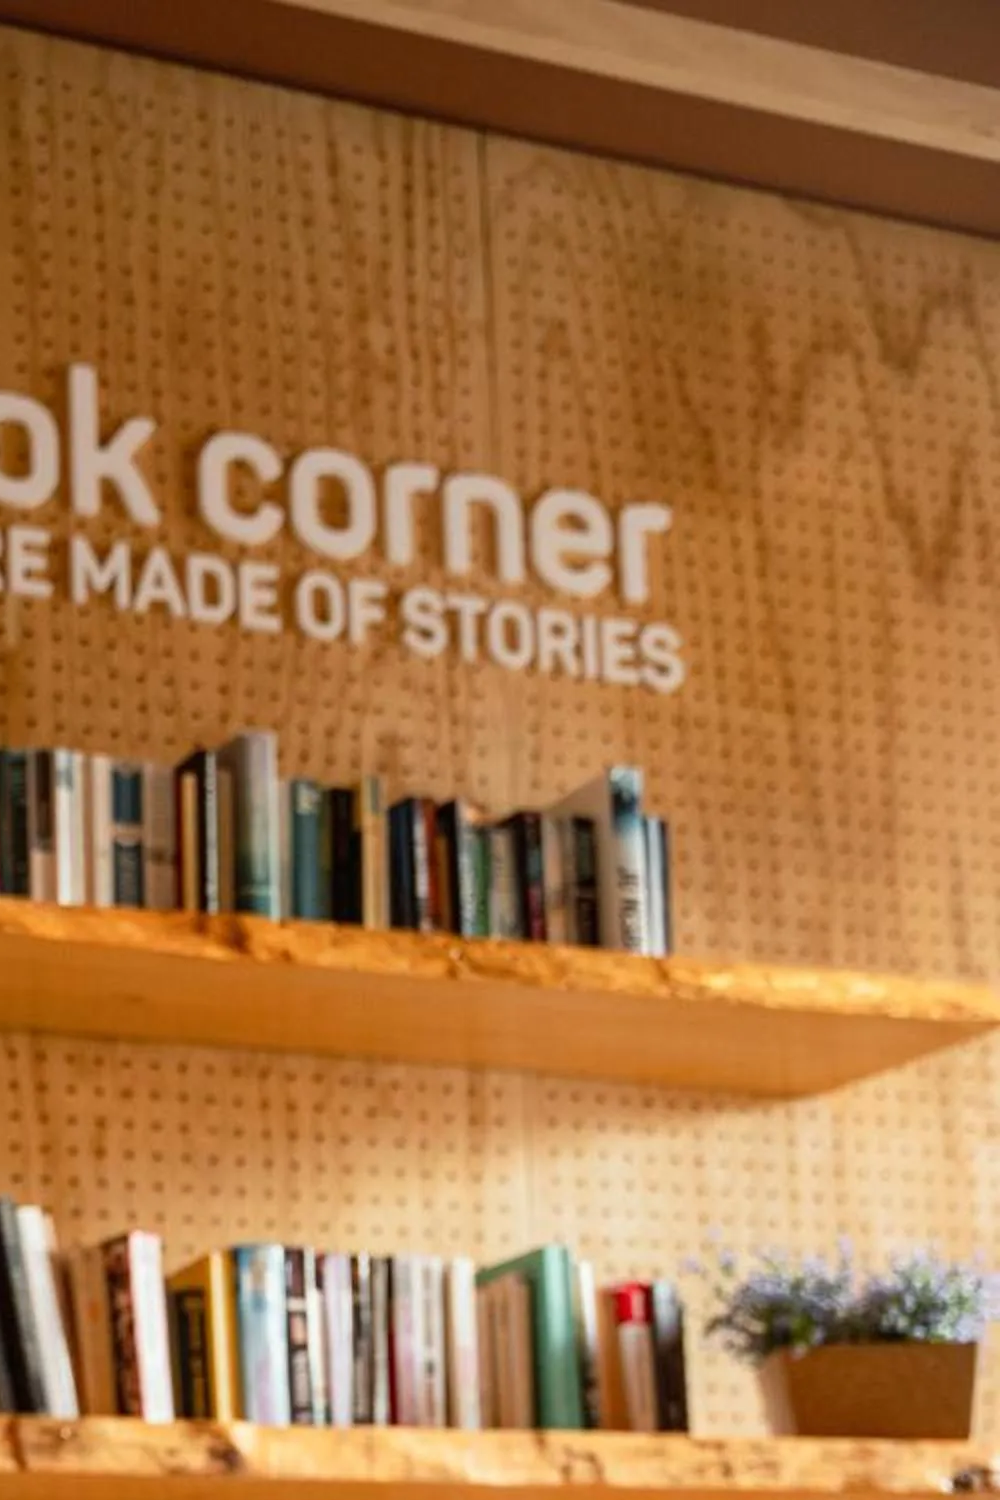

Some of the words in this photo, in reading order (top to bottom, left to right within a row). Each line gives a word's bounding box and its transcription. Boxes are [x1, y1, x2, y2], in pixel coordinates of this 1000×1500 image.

[199, 431, 671, 602] corner
[71, 536, 283, 631] MADE
[295, 570, 386, 643] OF
[402, 586, 686, 692] STORIES
